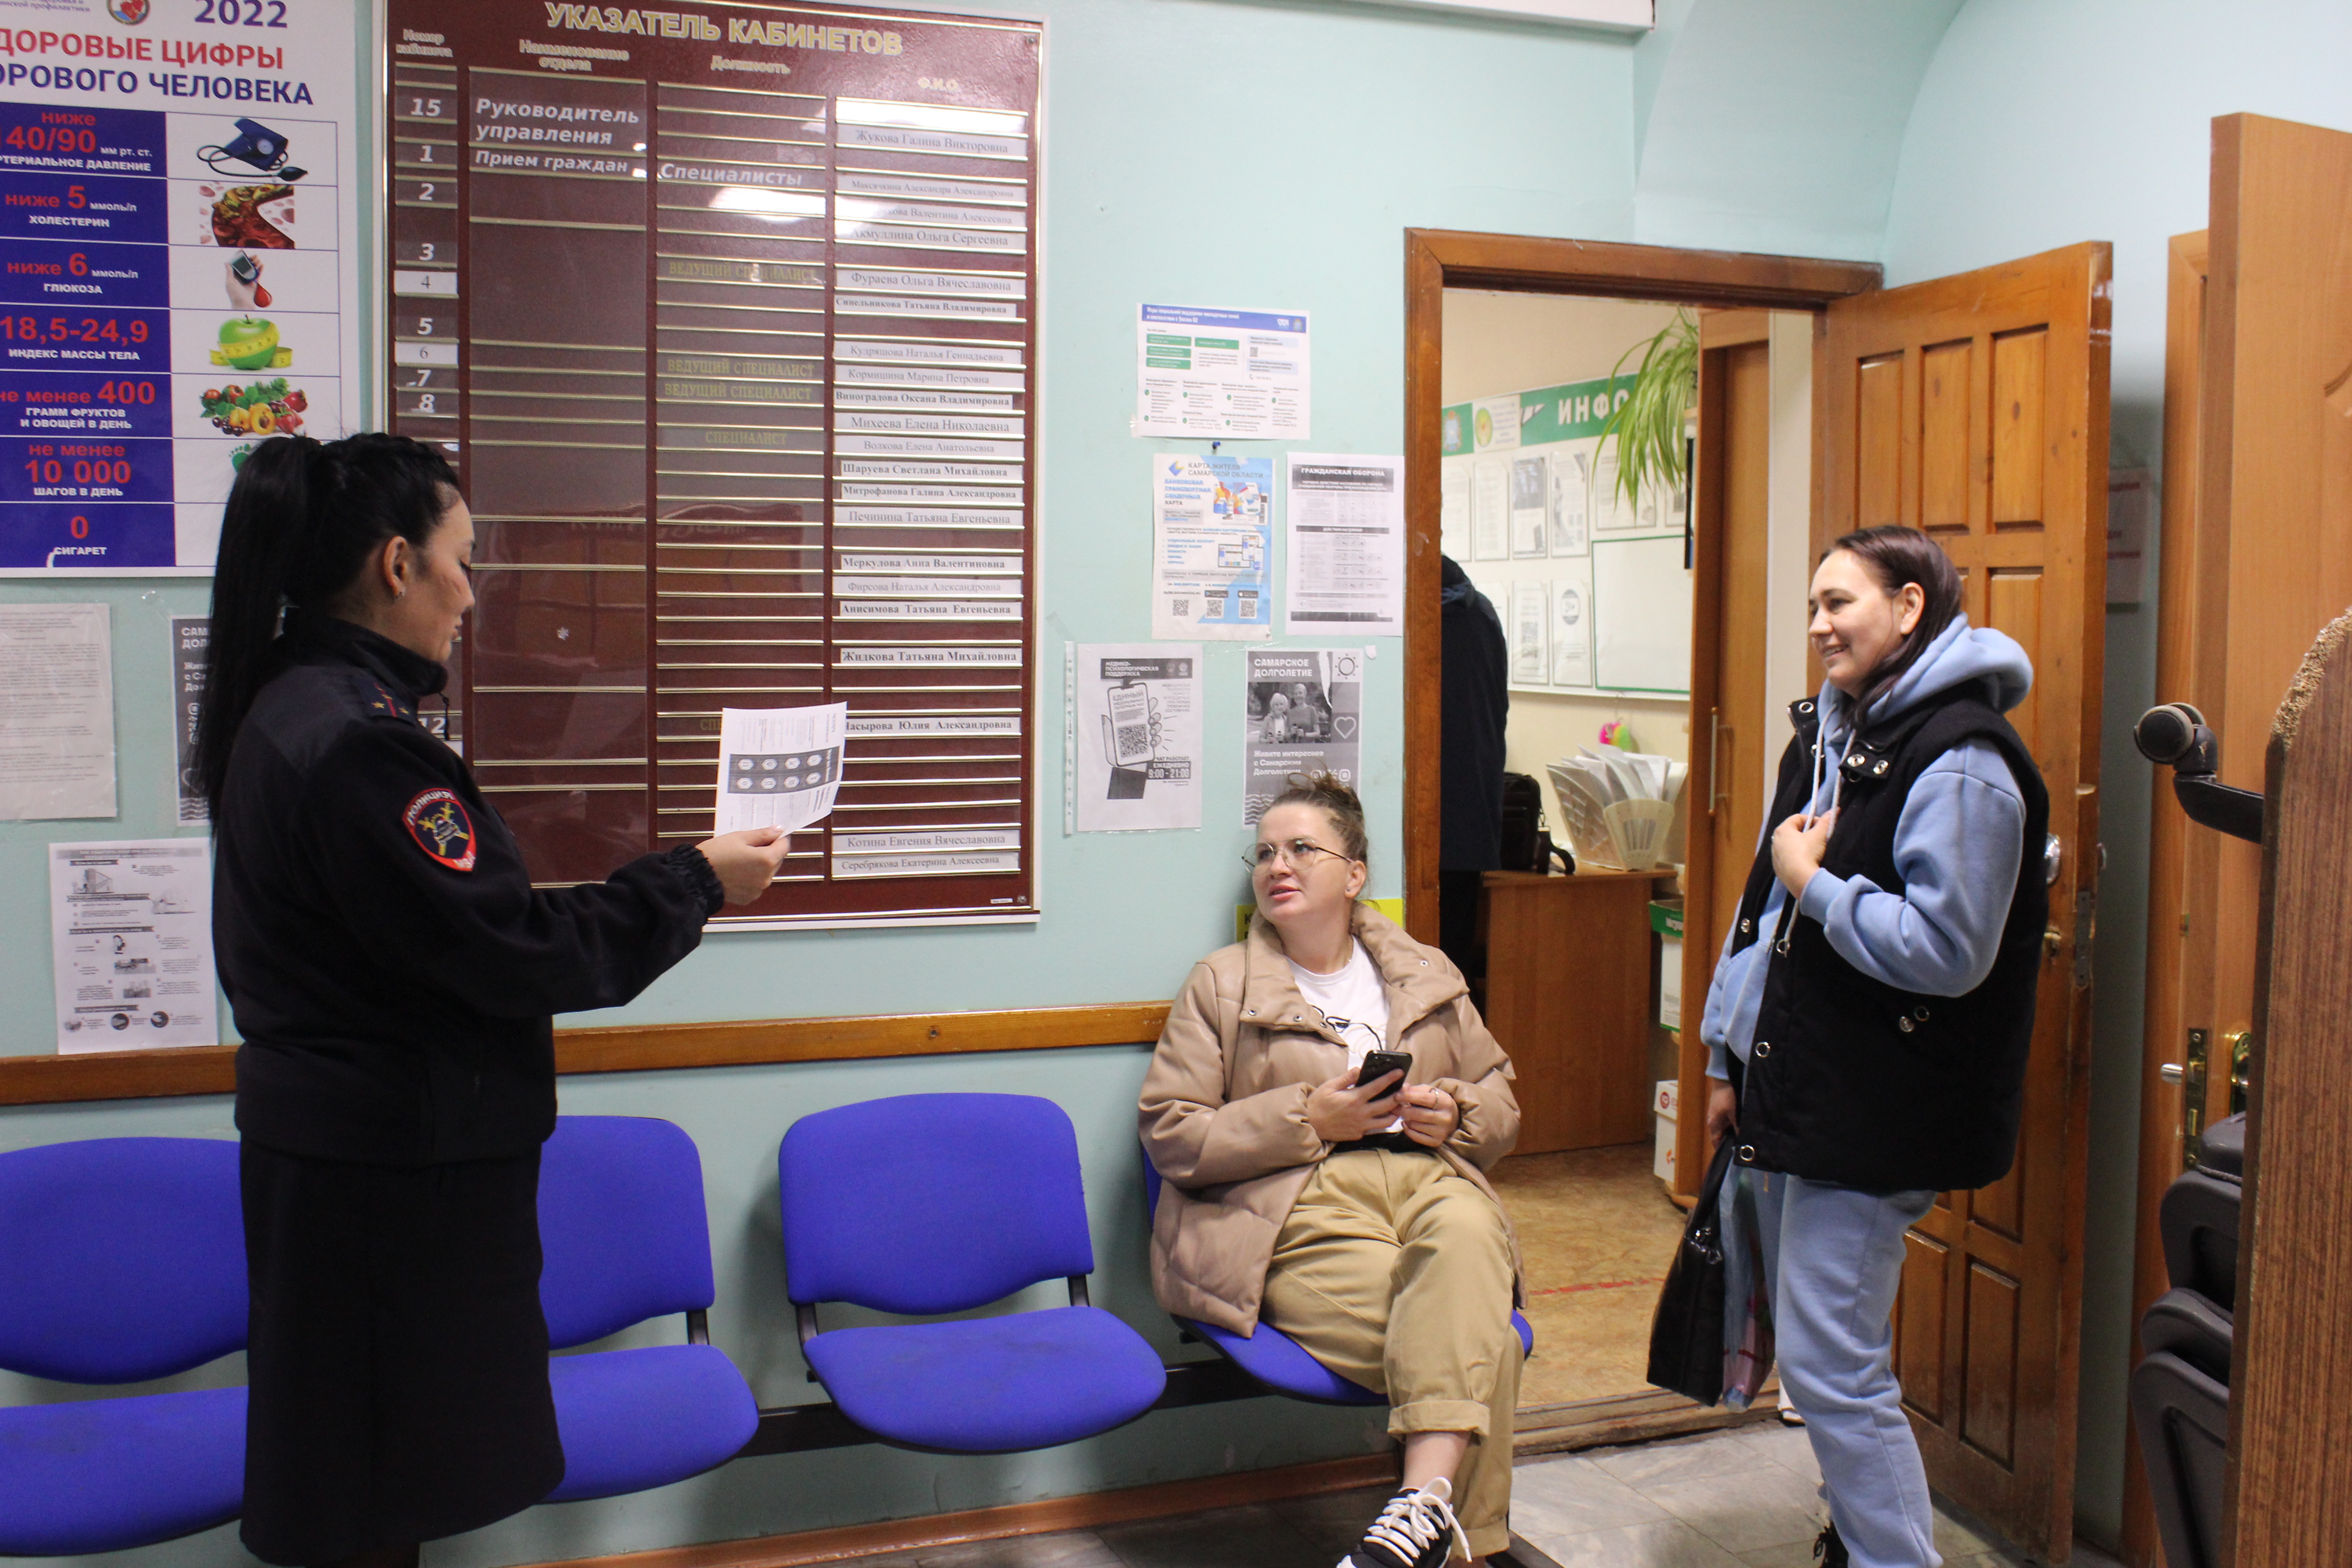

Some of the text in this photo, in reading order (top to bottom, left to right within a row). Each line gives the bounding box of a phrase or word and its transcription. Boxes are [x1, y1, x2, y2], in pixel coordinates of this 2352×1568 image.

[195, 0, 288, 28] 2022
[544, 2, 903, 56] УКАЗАТЕЛЬ КАБИНЕТОВ
[403, 29, 445, 45] Номер
[0, 28, 283, 70] ДОРОВЫЕ ЦИФРЫ
[519, 39, 630, 61] Наименование
[539, 57, 593, 71] отдела
[710, 55, 791, 74] Должность
[148, 72, 314, 105] ЧЕЛОВЕКА
[411, 98, 442, 117] 15
[476, 98, 640, 124] Руководитель
[41, 112, 96, 126] ниже
[475, 124, 612, 145] управления
[856, 130, 1008, 154] Жукова Галина Викторовна
[419, 145, 434, 163] 1
[475, 150, 628, 173] Прием граждан
[85, 159, 152, 172] ДАВЛЕНИЕ
[660, 163, 803, 185] Специалисты
[418, 183, 435, 201] 2
[905, 184, 951, 195] Александра
[5, 185, 137, 212] ниже 5 ммоль/л
[29, 215, 110, 227] ХОЛЕСТЕРИН
[911, 207, 959, 220] Валентина
[916, 230, 950, 242] Ольга
[952, 232, 1008, 247] Сергеевна
[419, 243, 435, 261] 3
[7, 252, 139, 279] ниже 6 ммоль/л
[669, 261, 732, 278] ВЕДУЩИЙ
[43, 283, 103, 294] ГЛЮКОЗА
[421, 275, 431, 289] 4
[902, 274, 934, 287] Ольга
[937, 277, 1012, 291] Вячеславовна
[835, 298, 1007, 315] Синельникова Татьяна Владимировна
[0, 316, 149, 347] 18,5-24,9
[417, 318, 434, 335] 5
[8, 348, 141, 361] ИНДЕКС МАССЫ ТЕЛА
[420, 346, 429, 359] 6
[906, 348, 943, 359] Наталья
[946, 350, 1004, 362] Геннадьевна
[667, 358, 815, 377] ВЕДУЩИЙ СПЕЦИАЛИСТ
[417, 370, 432, 387] 7
[907, 372, 944, 382] Марина
[946, 373, 990, 386] Петровна
[25, 381, 156, 405] менее 400
[665, 382, 813, 401] ВЕДУЩИЙ СПЕЦИАЛИСТ
[418, 394, 435, 412] 8
[835, 392, 1009, 407] Виноградова Оксана Владимировна
[25, 407, 127, 418] ГРАММ ФРУКТОВ
[1558, 389, 1630, 426] ИНФО
[20, 418, 132, 430] И ОВОЩЕЙ В ДЕНЬ
[851, 417, 1009, 432] Михеева Елена Николаевна
[706, 431, 788, 445] СПЕЦИАЛИСТ
[29, 444, 126, 456] не менее
[864, 441, 995, 453] Волкова Елена Анатольевна
[24, 459, 132, 484] 10 000
[843, 463, 1008, 477] Шаруева Светлана Михайловна
[1301, 467, 1352, 475] ГРАЖДАНСКАЯ
[33, 487, 124, 498] ШАГОВ В ДЕНЬ
[843, 486, 1017, 500] Митрофанова Галина Александровна
[905, 512, 948, 523] Татьяна
[951, 513, 1011, 524] Евгеньевна
[70, 515, 89, 539] 0
[53, 546, 108, 556] СИГАРЕТ
[843, 558, 1005, 569] Меркулова Анна Валентиновна
[891, 583, 928, 592] Наталья
[931, 583, 1001, 593] Александровна
[842, 604, 1011, 614] Анисимова Татьяна Евгеньевна
[842, 651, 1017, 662] Жидкова Татьяна Михайловна
[1254, 658, 1309, 667] САМАРСКОЕ
[1254, 668, 1313, 678] ДОЛГОЛЕТИЕ
[899, 720, 1012, 731] Юлия Александровна
[1259, 759, 1302, 767] Самарским
[407, 790, 455, 826] ПОЛИЦИЯ
[847, 835, 1005, 848] Котина Евгения Вячеславовна
[842, 855, 1000, 871] Серебрякова Екатерина Алексеевна
